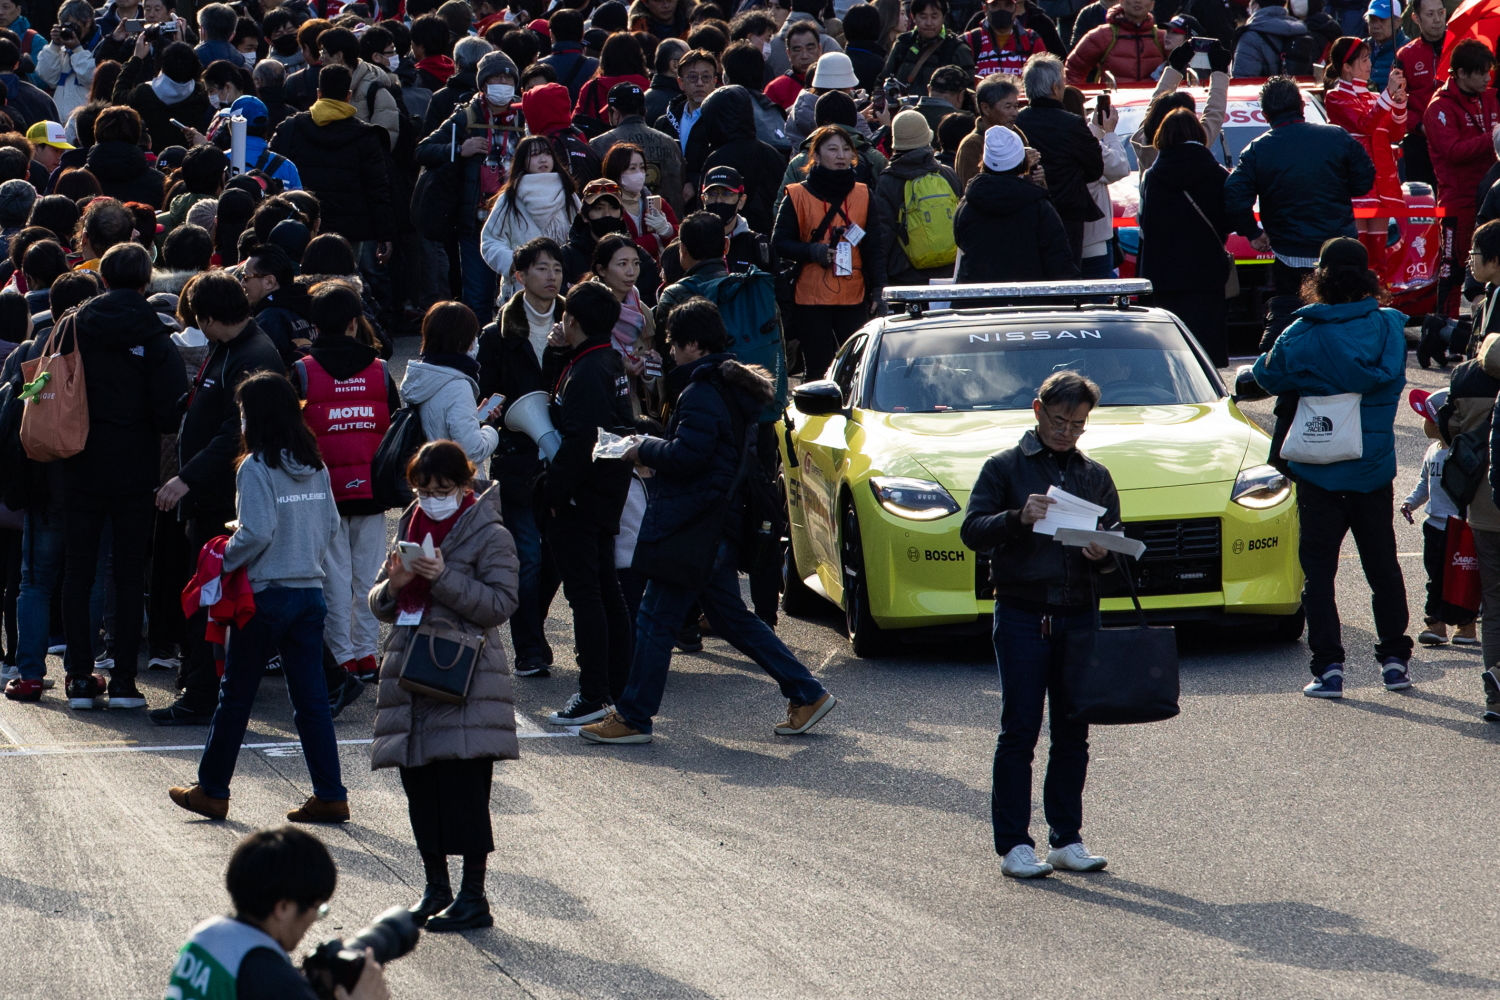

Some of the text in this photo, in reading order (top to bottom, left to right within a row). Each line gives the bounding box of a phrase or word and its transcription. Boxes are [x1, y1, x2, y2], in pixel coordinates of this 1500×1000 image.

[968, 328, 1102, 344] NISSAN
[334, 377, 366, 385] NISSAN
[334, 384, 367, 393] nismo
[327, 406, 375, 419] MOTUL
[326, 421, 377, 432] AUTECH
[1248, 536, 1279, 551] BOSCH
[924, 550, 965, 561] BOSCH
[176, 950, 211, 996] DIA
